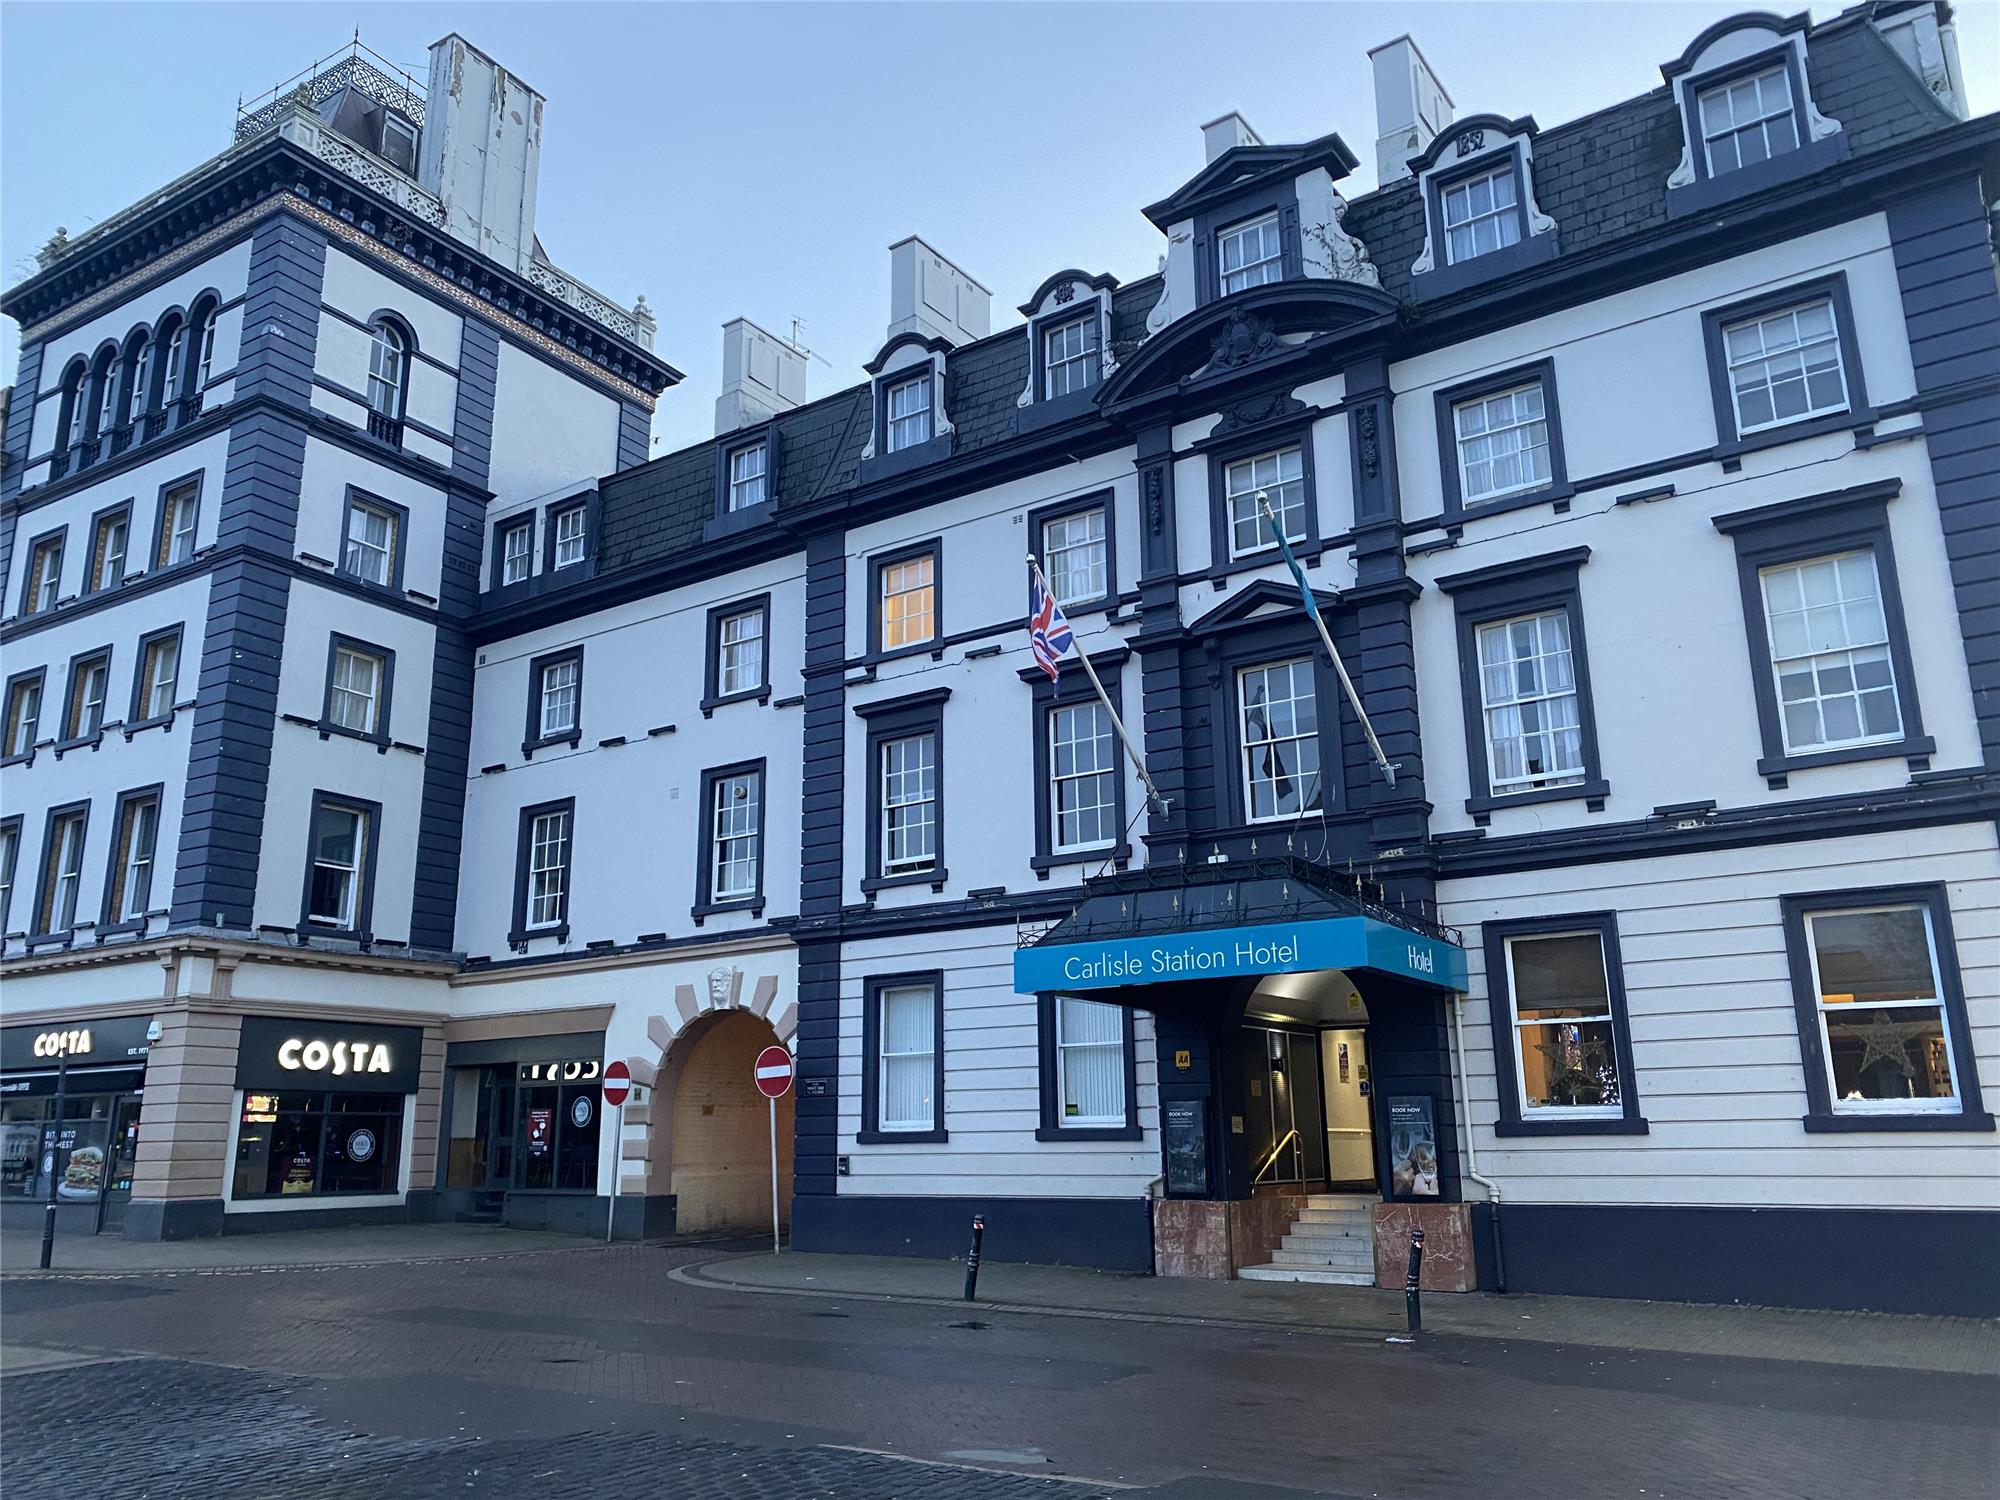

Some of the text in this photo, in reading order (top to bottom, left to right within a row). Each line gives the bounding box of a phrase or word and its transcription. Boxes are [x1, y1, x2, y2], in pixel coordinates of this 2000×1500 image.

[1456, 130, 1486, 158] 1852
[1065, 935, 1298, 980] Carlisle Station Hotel
[1408, 945, 1433, 974] Hotel
[34, 1029, 91, 1057] COSTA
[278, 1039, 390, 1075] COSTA
[1178, 1054, 1188, 1064] AA
[45, 1130, 76, 1139] BIT INTO
